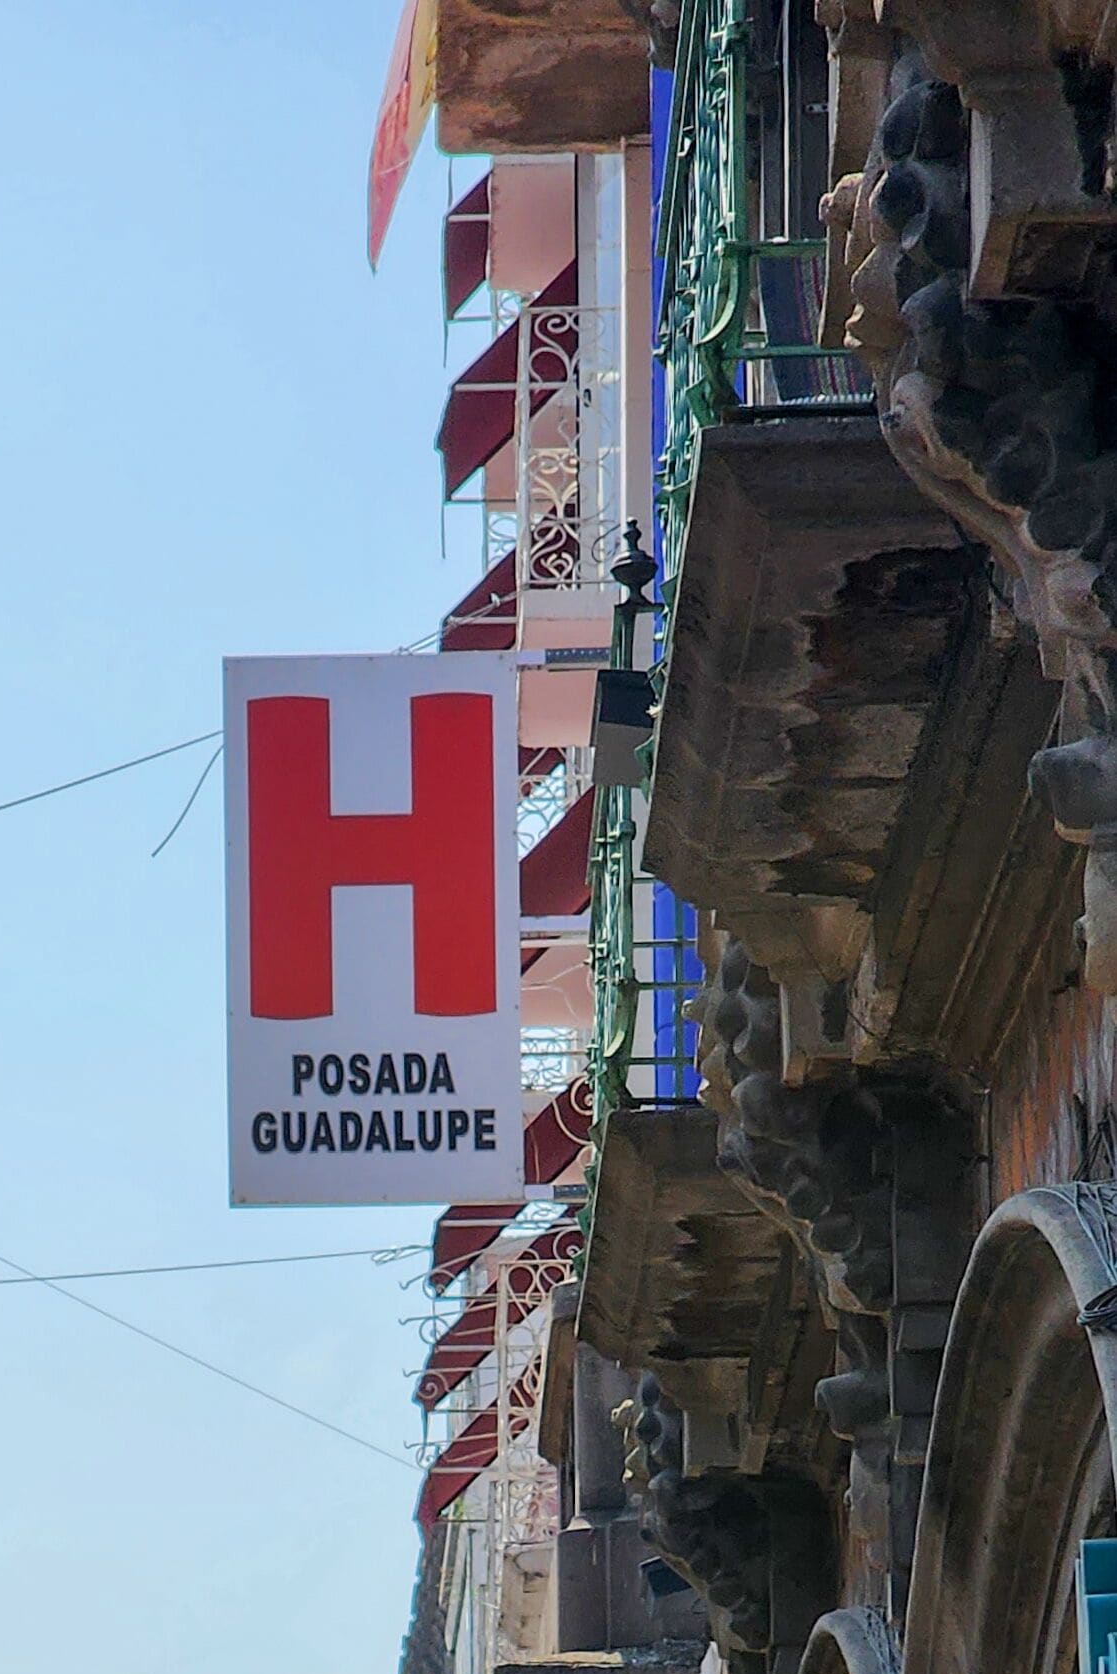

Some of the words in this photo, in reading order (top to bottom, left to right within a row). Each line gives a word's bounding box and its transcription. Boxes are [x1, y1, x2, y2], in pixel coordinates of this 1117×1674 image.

[247, 691, 497, 1020] H
[291, 1052, 456, 1097] POSADA
[251, 1108, 497, 1153] GUADALUPE
